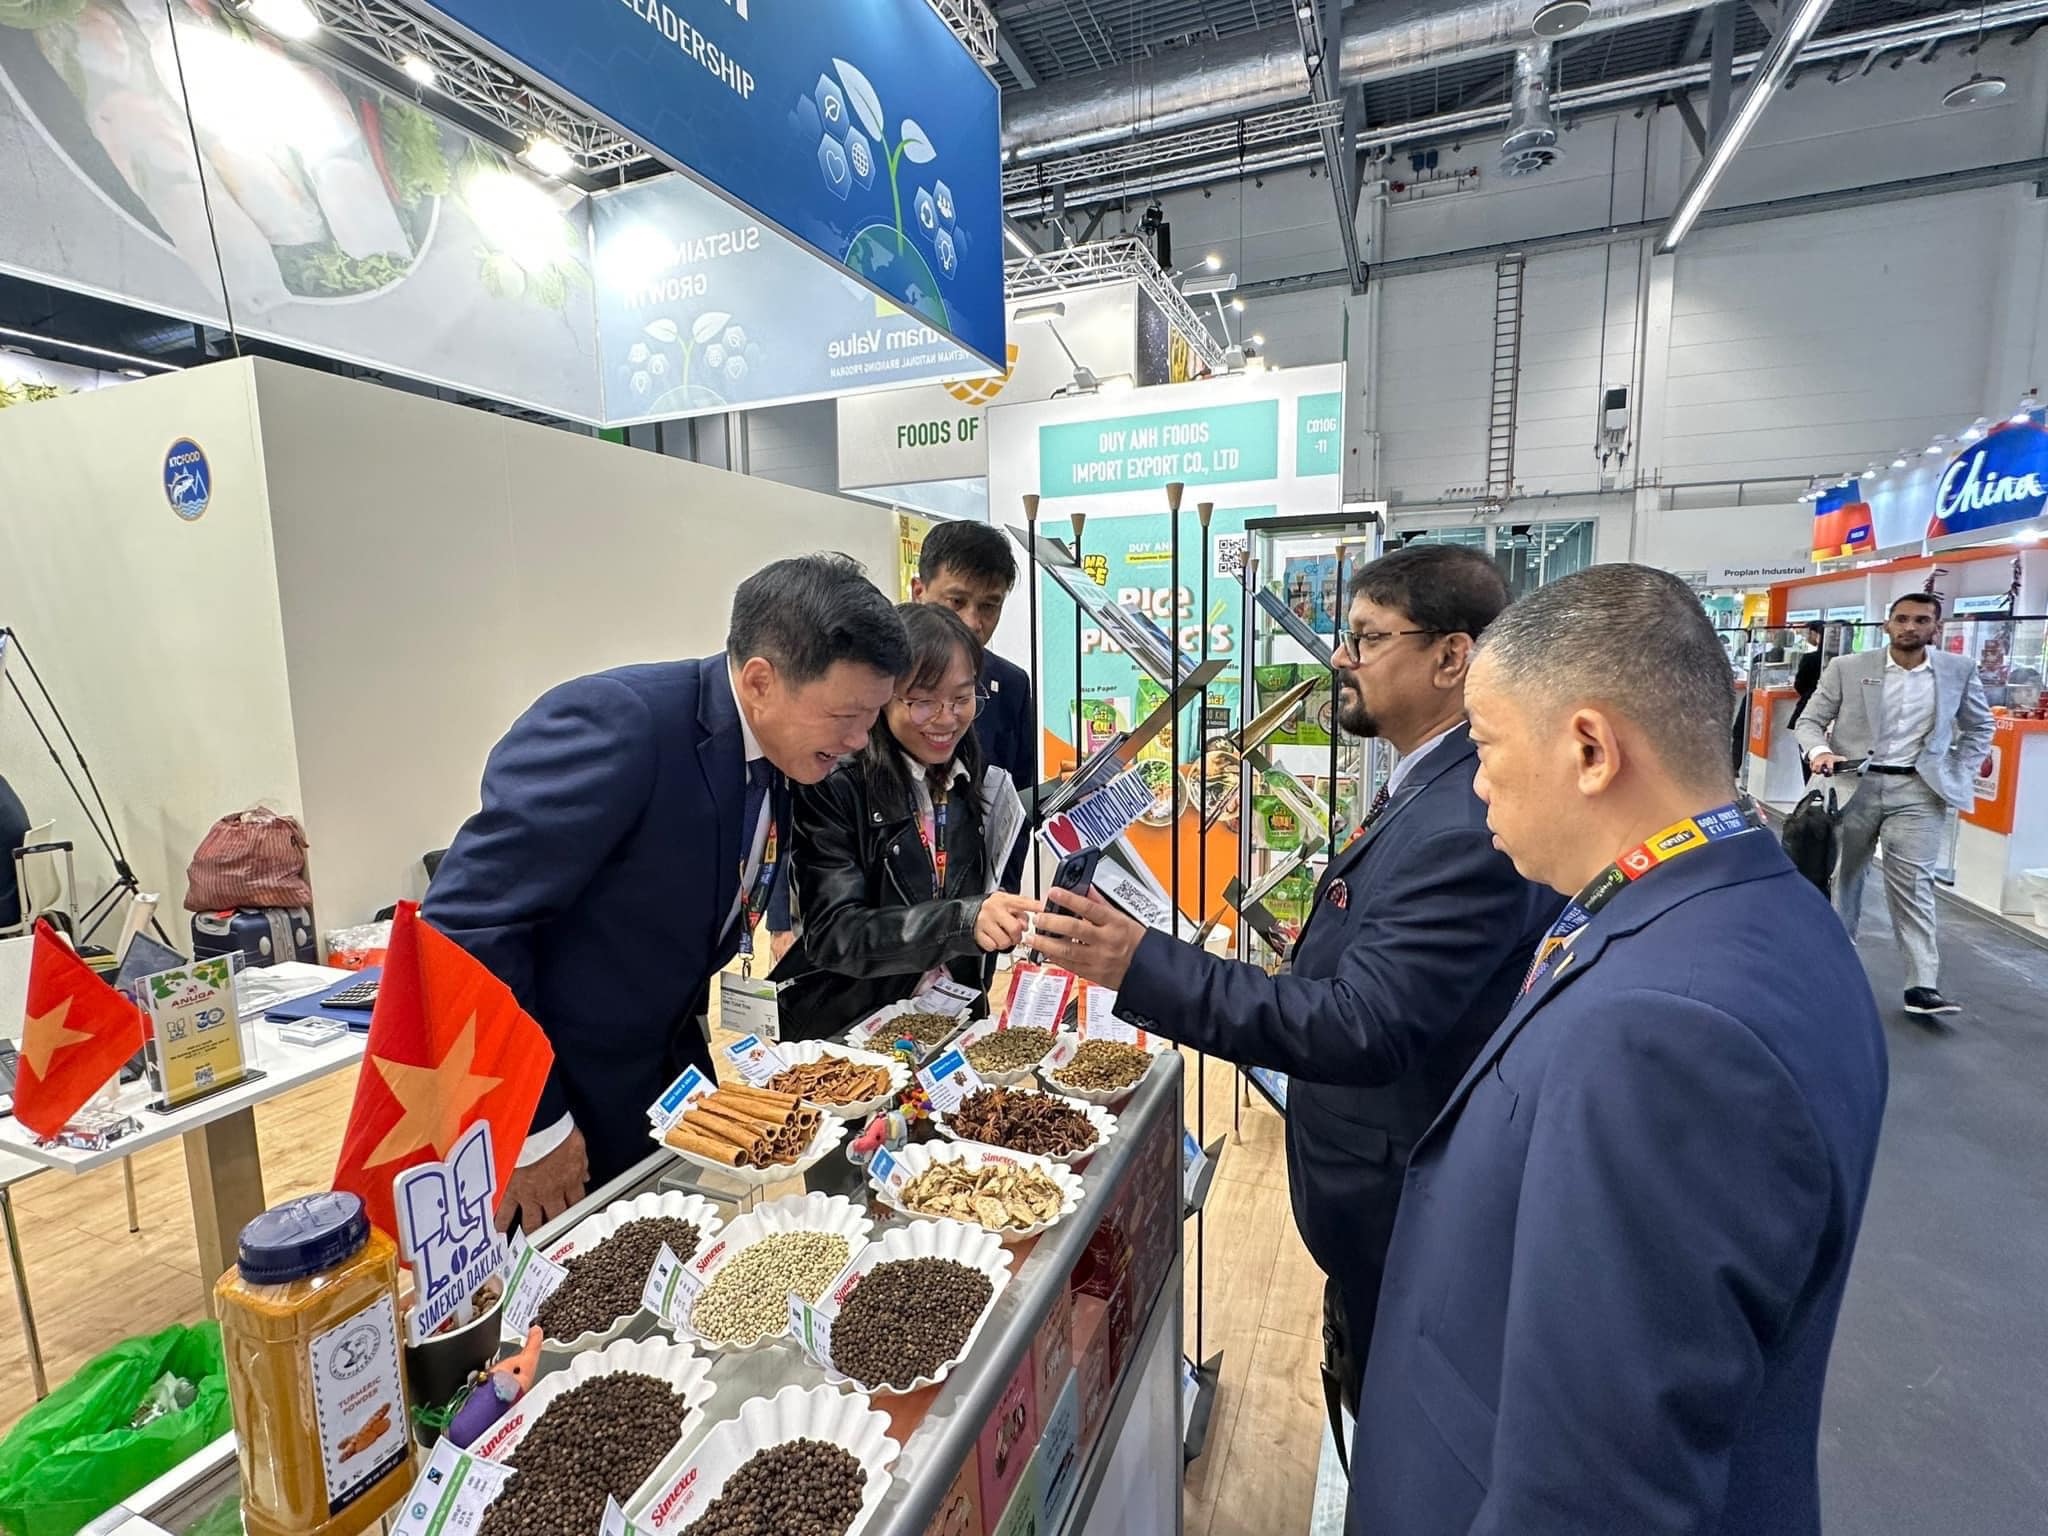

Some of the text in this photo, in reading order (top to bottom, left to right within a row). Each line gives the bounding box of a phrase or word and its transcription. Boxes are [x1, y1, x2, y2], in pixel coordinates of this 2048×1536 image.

[621, 0, 755, 99] EADERSHIP
[897, 417, 979, 449] FOODS OF
[1099, 422, 1209, 454] DUY ANH FOODS
[1072, 462, 1122, 484] IMPORT
[1127, 454, 1178, 480] EXPORT
[1213, 448, 1239, 471] LTD
[1935, 449, 2048, 519] China
[1154, 542, 1172, 551] AN
[1724, 566, 1805, 578] Proplan Industrial
[1069, 786, 1127, 847] SIMEXCO
[171, 990, 215, 1008] ANUGA
[696, 1240, 726, 1273] Simexco
[418, 1281, 465, 1336] SIMEXCO
[467, 1246, 503, 1292] DAKLAK
[338, 1376, 381, 1409] TURMERIC
[343, 1387, 379, 1415] POWDER
[651, 1466, 698, 1528] Simexco
